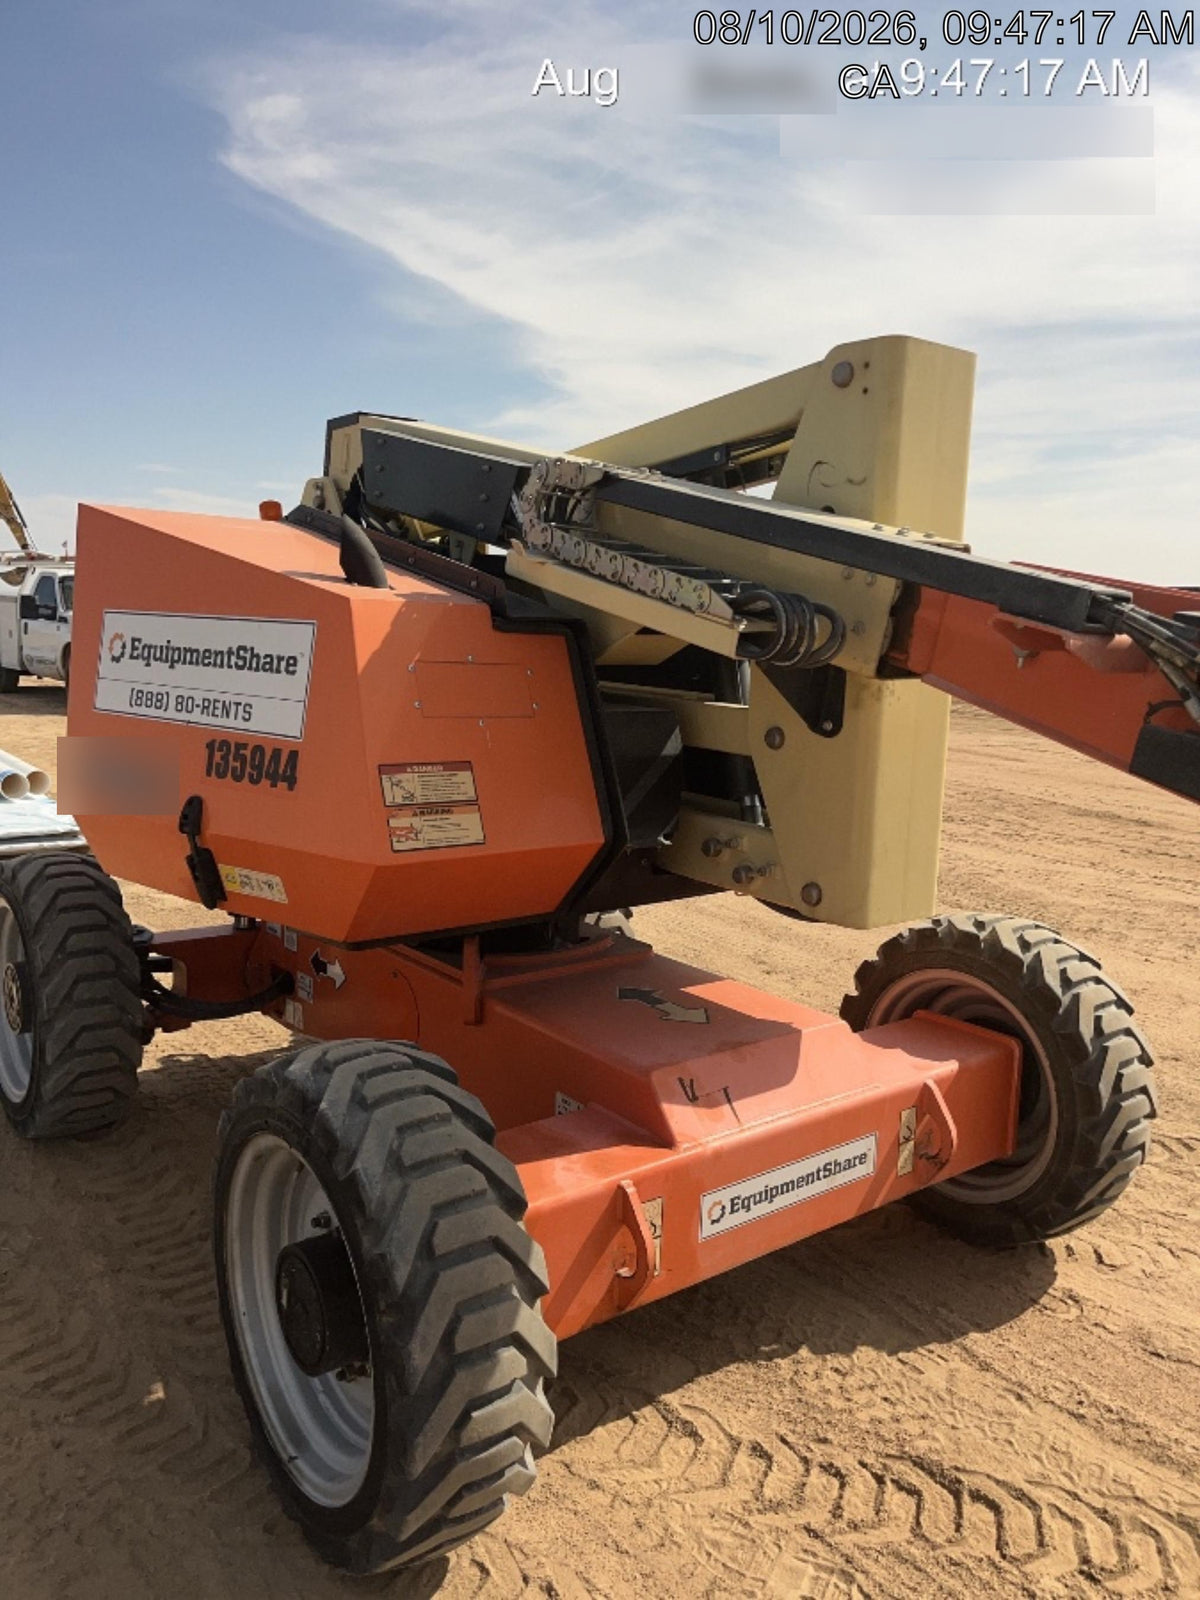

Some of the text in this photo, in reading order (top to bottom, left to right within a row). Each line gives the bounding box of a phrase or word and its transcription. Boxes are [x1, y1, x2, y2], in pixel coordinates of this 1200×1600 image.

[129, 637, 298, 675] EquipmentShare
[128, 686, 253, 722] (888) 80-RENTS
[205, 738, 300, 792] 135944
[728, 1151, 868, 1216] EquipmentShare
